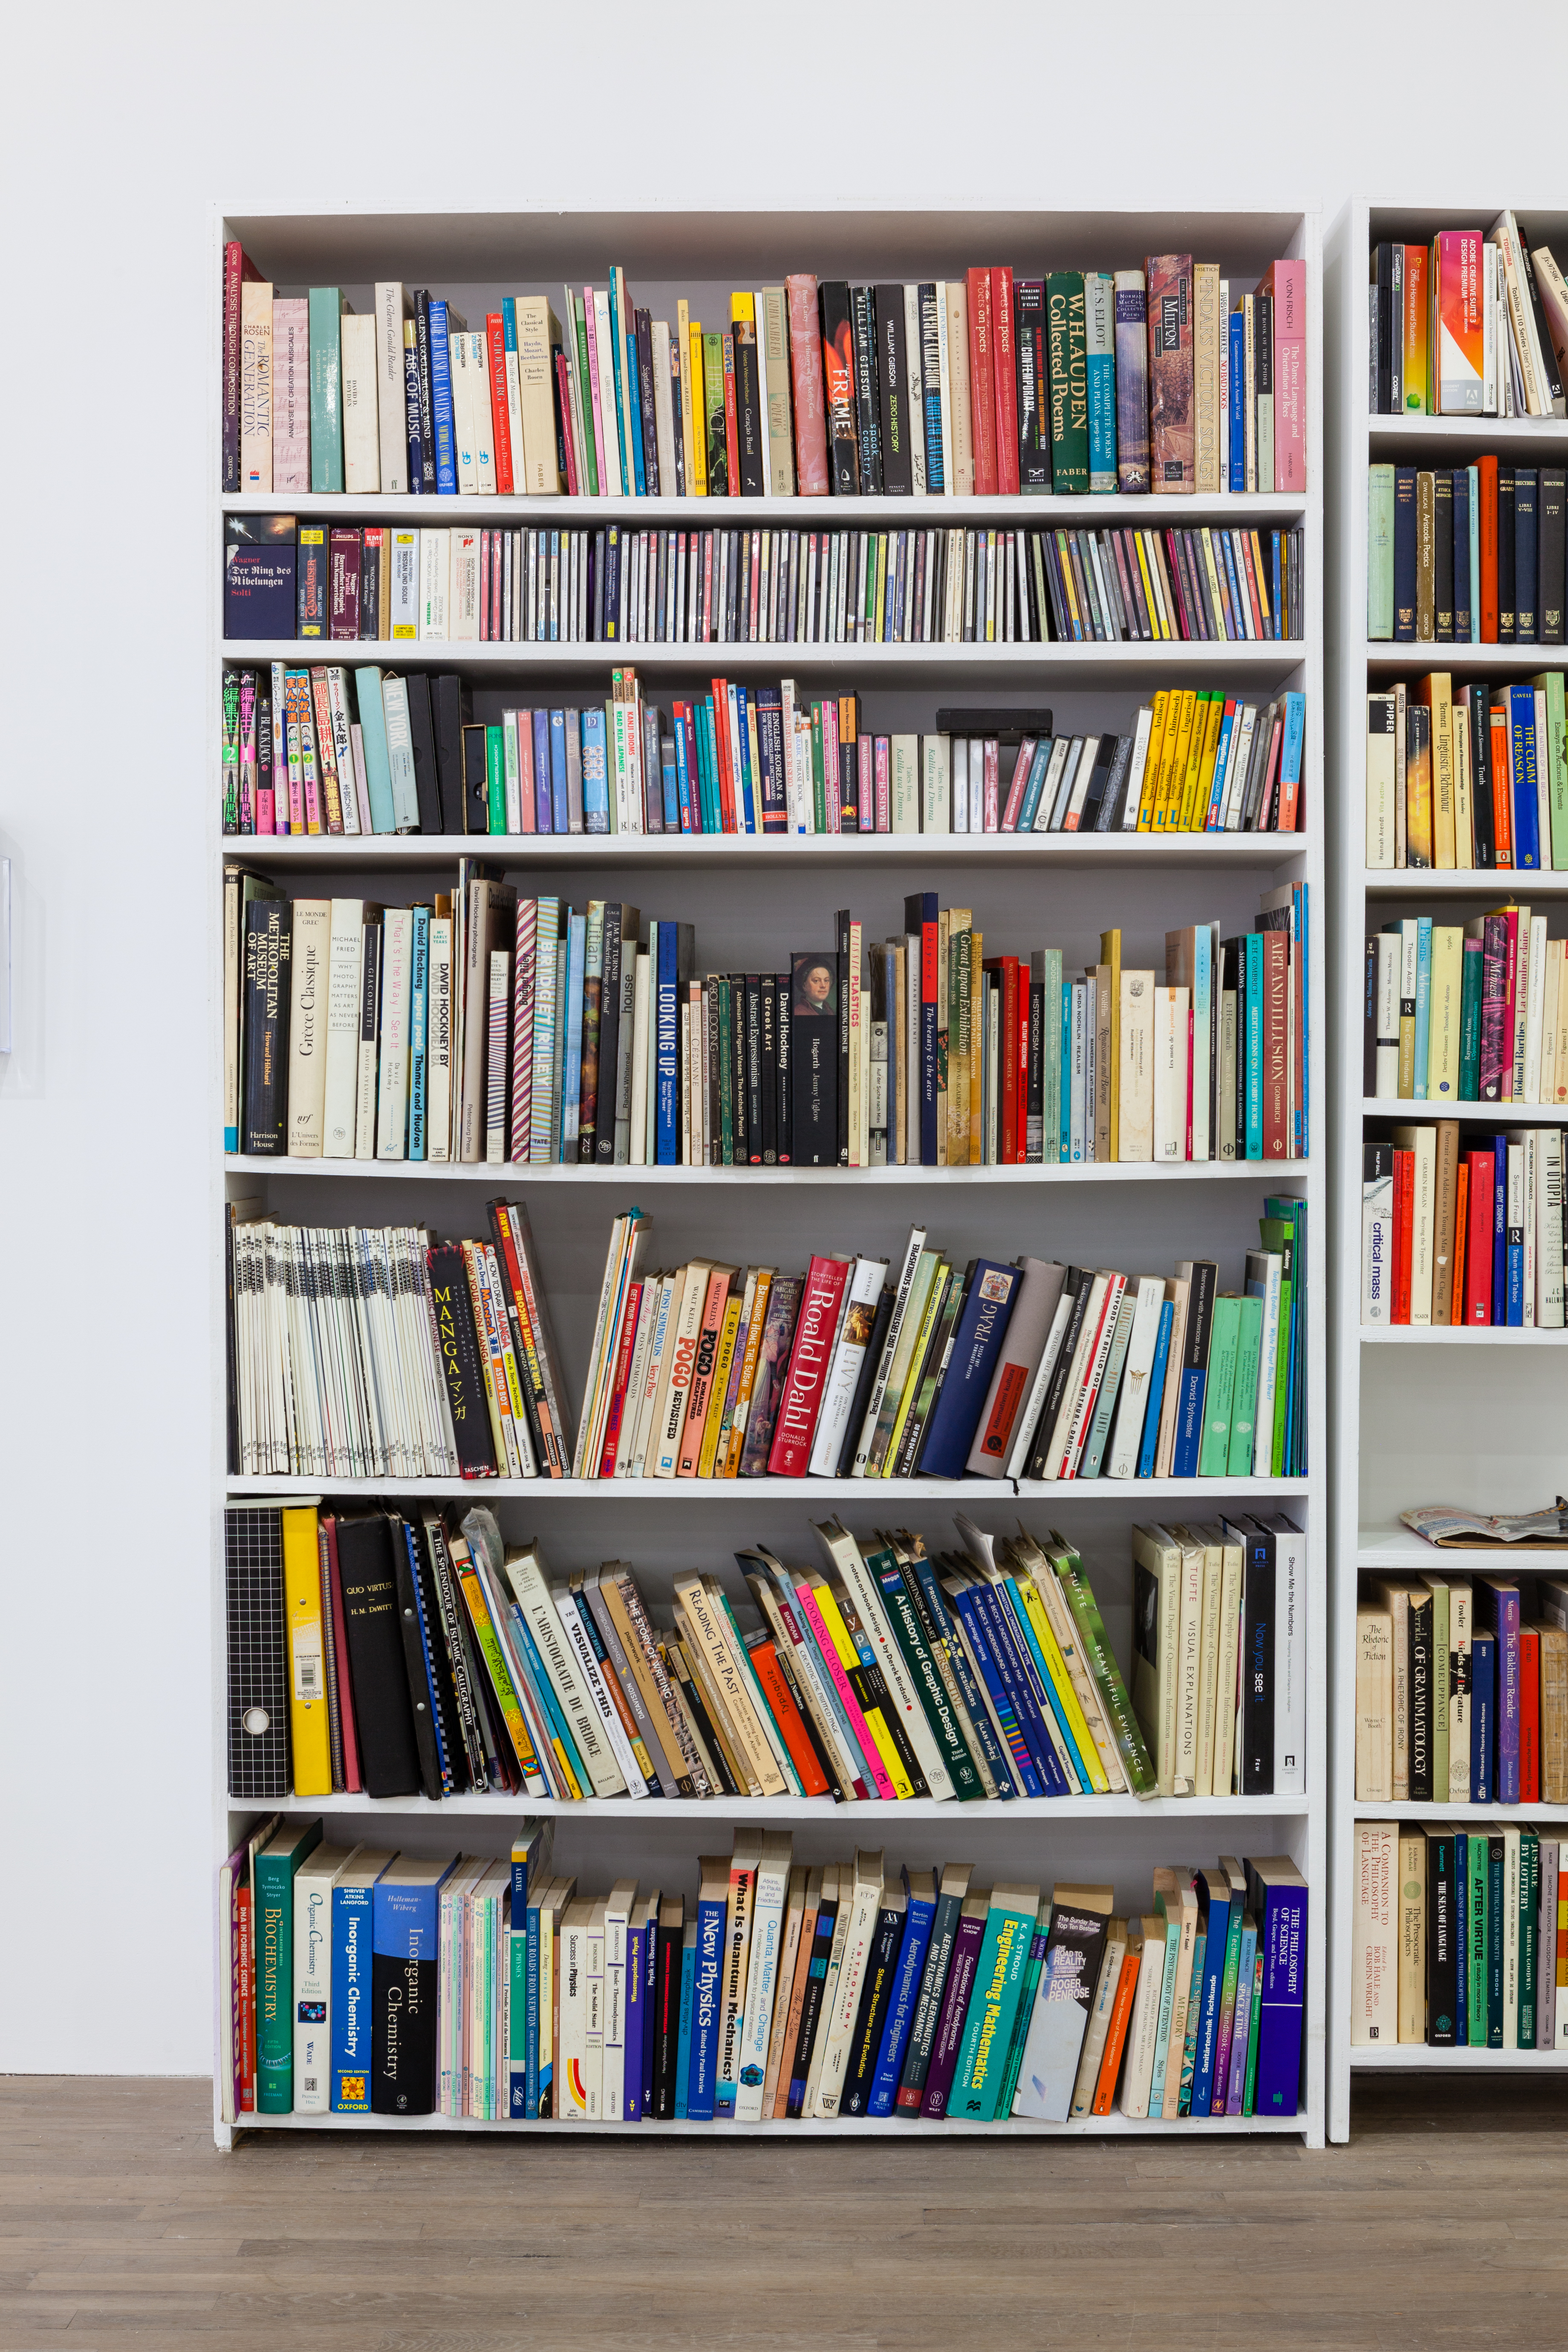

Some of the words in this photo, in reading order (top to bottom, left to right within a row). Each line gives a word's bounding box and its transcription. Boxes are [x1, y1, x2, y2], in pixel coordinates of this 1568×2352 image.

[1503, 238, 1512, 267] TOSHIBA
[1049, 294, 1066, 377] Collected
[228, 352, 236, 416] COMPOSITION
[493, 331, 505, 401] SCHOENBERG
[1199, 350, 1213, 420] VICTORY
[243, 340, 255, 437] GENERATION
[256, 355, 269, 437] ROMANTIC
[1052, 380, 1068, 442] Poems
[891, 415, 899, 453] HISTORY
[1200, 426, 1213, 479] SONGS
[231, 575, 283, 587] Nibelungen
[286, 677, 297, 723] まんが道
[298, 677, 310, 723] まんが道
[1155, 696, 1165, 730] Arabisch
[1168, 696, 1180, 736] Chinesisch
[1181, 695, 1193, 733] Ungarisch
[773, 712, 781, 793] ENGLISH-KOREAN
[1437, 734, 1449, 771] Linguistic
[1514, 725, 1522, 739] OF
[1525, 725, 1533, 747] THE
[1514, 742, 1524, 783] REASON
[1526, 750, 1536, 783] CLAIM
[1440, 773, 1450, 813] Behaviour
[417, 918, 426, 946] David
[587, 920, 603, 964] Titian
[1420, 926, 1431, 962] Prisms
[257, 932, 266, 990] MUSEUM
[267, 913, 279, 1019] METROPOLITAN
[413, 950, 424, 989] Hockney
[1272, 939, 1283, 970] ART
[300, 945, 319, 1009] Classique
[538, 942, 552, 1029] BRIDGET
[1272, 972, 1283, 1005] AND
[1418, 971, 1429, 1008] Adorno
[299, 1014, 314, 1056] Grèce
[658, 984, 676, 1051] LOOKING
[537, 1032, 551, 1086] RILEY
[811, 1038, 820, 1069] Hogarth
[1271, 1008, 1283, 1081] ILLUSION
[1516, 1021, 1525, 1059] Barthes
[415, 1054, 423, 1089] Thames
[659, 1056, 675, 1076] UP
[1514, 1063, 1523, 1096] Roland
[1548, 1171, 1560, 1207] UTOPIA
[1373, 1222, 1383, 1262] critical
[1372, 1266, 1380, 1300] mass
[434, 1287, 460, 1375] MANGA
[801, 1287, 834, 1361] Roald
[784, 1367, 819, 1430] Dahl
[1188, 1376, 1198, 1401] David
[667, 1390, 683, 1439] REVISITED
[1186, 1402, 1196, 1438] Sylvester
[347, 1586, 364, 1595] QUO
[882, 1574, 899, 1584] Meggs
[689, 1589, 716, 1641] READING
[438, 1557, 452, 1610] SPLENDOUR
[450, 1626, 462, 1662] ISLAMIC
[456, 1665, 473, 1726] CALLIGRAPHY
[572, 1623, 604, 1690] VISUALIZE
[803, 1595, 829, 1646] LOOKING
[826, 1649, 847, 1692] CLOSER
[1188, 1620, 1196, 1661] VISUAL
[1363, 1635, 1389, 1644] Rhetoric
[1507, 1651, 1515, 1686] Bakhtin
[921, 1660, 943, 1706] Graphic
[938, 1704, 959, 1748] Design
[1094, 1645, 1122, 1709] BEAUTIFUL
[1118, 1714, 1144, 1772] EVIDENCE
[1184, 1665, 1194, 1755] EXPLANATIONS
[1415, 1665, 1426, 1776] GRAMMATOLOGY
[576, 1716, 601, 1759] BRIDGE
[1371, 1857, 1379, 1921] PHILOSOPHY
[1474, 1878, 1483, 1916] AFTER
[1520, 1861, 1529, 1912] LOTTERY
[347, 1917, 360, 1984] Inorganic
[702, 1918, 720, 1958] New
[1278, 1930, 1289, 1965] SCIENCE
[1474, 1919, 1483, 1961] VIRTUE
[265, 1907, 282, 2022] BIOCHEMISTRY
[986, 1919, 1019, 2001] Engineering
[1011, 1945, 1023, 1981] STROUD
[1288, 1927, 1299, 1994] PHILOSOPHY
[569, 1967, 578, 1997] Physics
[696, 1961, 717, 2027] Physics
[1048, 1988, 1090, 2002] PENROSE
[1207, 1975, 1217, 2016] Fachkunde
[347, 1986, 359, 2057] Chemistry
[970, 2004, 1001, 2090] Mathematics
[1201, 2019, 1214, 2073] Sanitärtechnik
